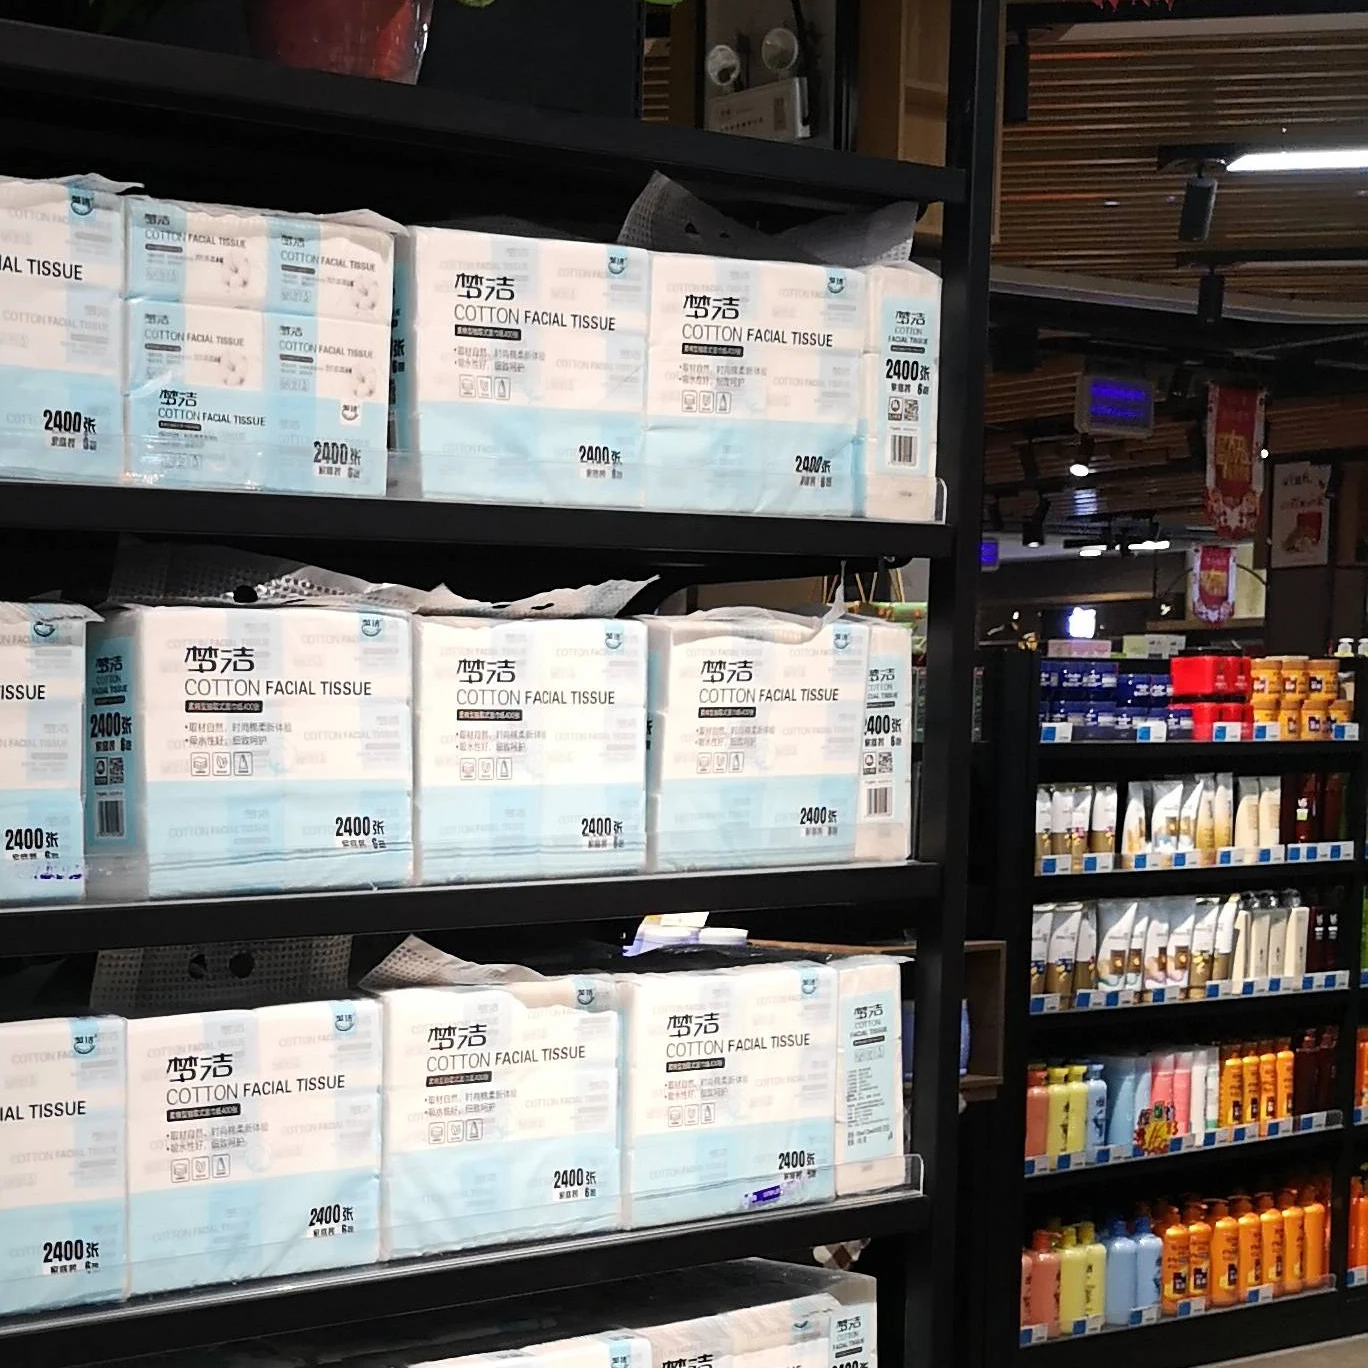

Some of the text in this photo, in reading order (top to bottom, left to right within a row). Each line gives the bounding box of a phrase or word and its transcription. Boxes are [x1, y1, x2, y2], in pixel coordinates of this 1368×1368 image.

[145, 230, 245, 248] COTTON FACIAL TISSUE
[27, 259, 82, 280] TISSUE
[683, 295, 739, 320] 梦洁
[683, 325, 832, 347] COTTON FACIAL TISSUE
[886, 359, 929, 380] 2400张
[43, 410, 96, 433] 2400张
[159, 408, 264, 426] COTTON FACIAL TISSUE
[314, 441, 360, 465] 2400张
[796, 456, 830, 473] 2400张
[185, 646, 254, 673] 梦洁
[701, 660, 753, 683] 梦洁
[185, 679, 371, 695] COTTON FACIAL TISSUE
[699, 688, 838, 705] COTTON FACIAL TISSUE
[90, 712, 131, 738] 2400张
[336, 817, 384, 836] 2400张
[800, 807, 836, 824] 2400张
[5, 828, 58, 850] 2400张
[667, 1013, 719, 1037] 梦洁
[428, 1024, 486, 1050] 梦洁
[666, 1033, 810, 1058] COTTON FACIAL TISSUE
[167, 1053, 232, 1082] 梦洁
[428, 1046, 585, 1071] COTTON FACIAL TISSUE
[167, 1075, 344, 1105] COTTON FACIAL TISSUE
[29, 1101, 86, 1118] TISSUE
[779, 1151, 814, 1170] 2400张
[554, 1168, 596, 1188] 2400张
[309, 1204, 353, 1226] 2400张
[44, 1240, 99, 1263] 2400张
